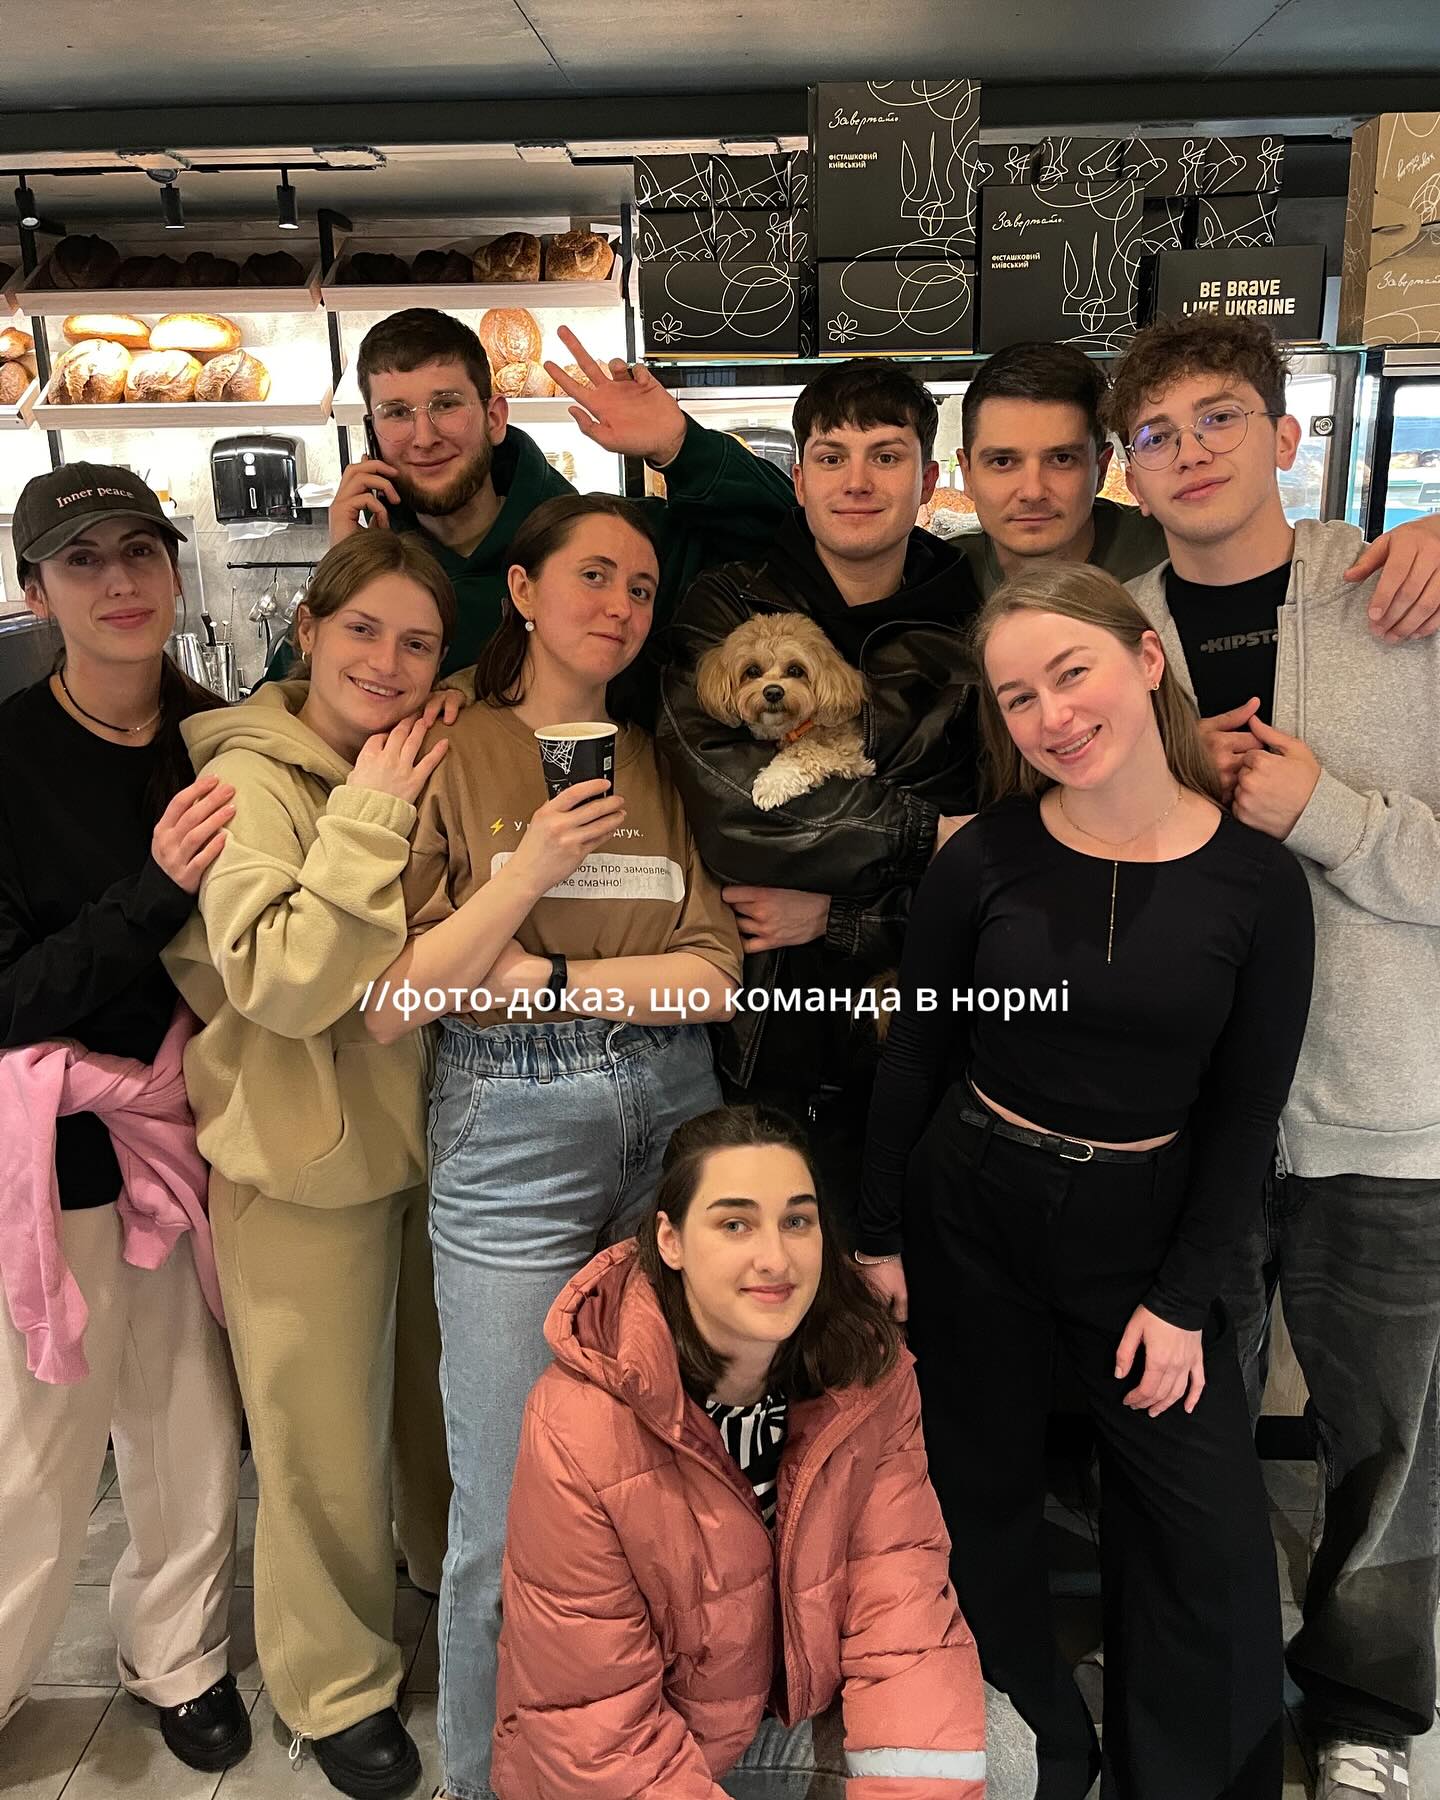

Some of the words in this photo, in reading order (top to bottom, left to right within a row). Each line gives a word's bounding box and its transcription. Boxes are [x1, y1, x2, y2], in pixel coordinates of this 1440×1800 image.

[828, 151, 878, 161] ФІСТАШКОВИЙ
[828, 160, 867, 169] КИЇВСЬКИЙ
[991, 252, 1041, 262] ФІСТАШКОВИЙ
[991, 260, 1029, 269] КИЇВСЬКИЙ
[1200, 281, 1221, 298] BE
[56, 488, 94, 509] Inner
[97, 486, 136, 499] peace
[612, 827, 644, 839] дгук.
[600, 864, 621, 875] про
[577, 878, 622, 888] смачно!
